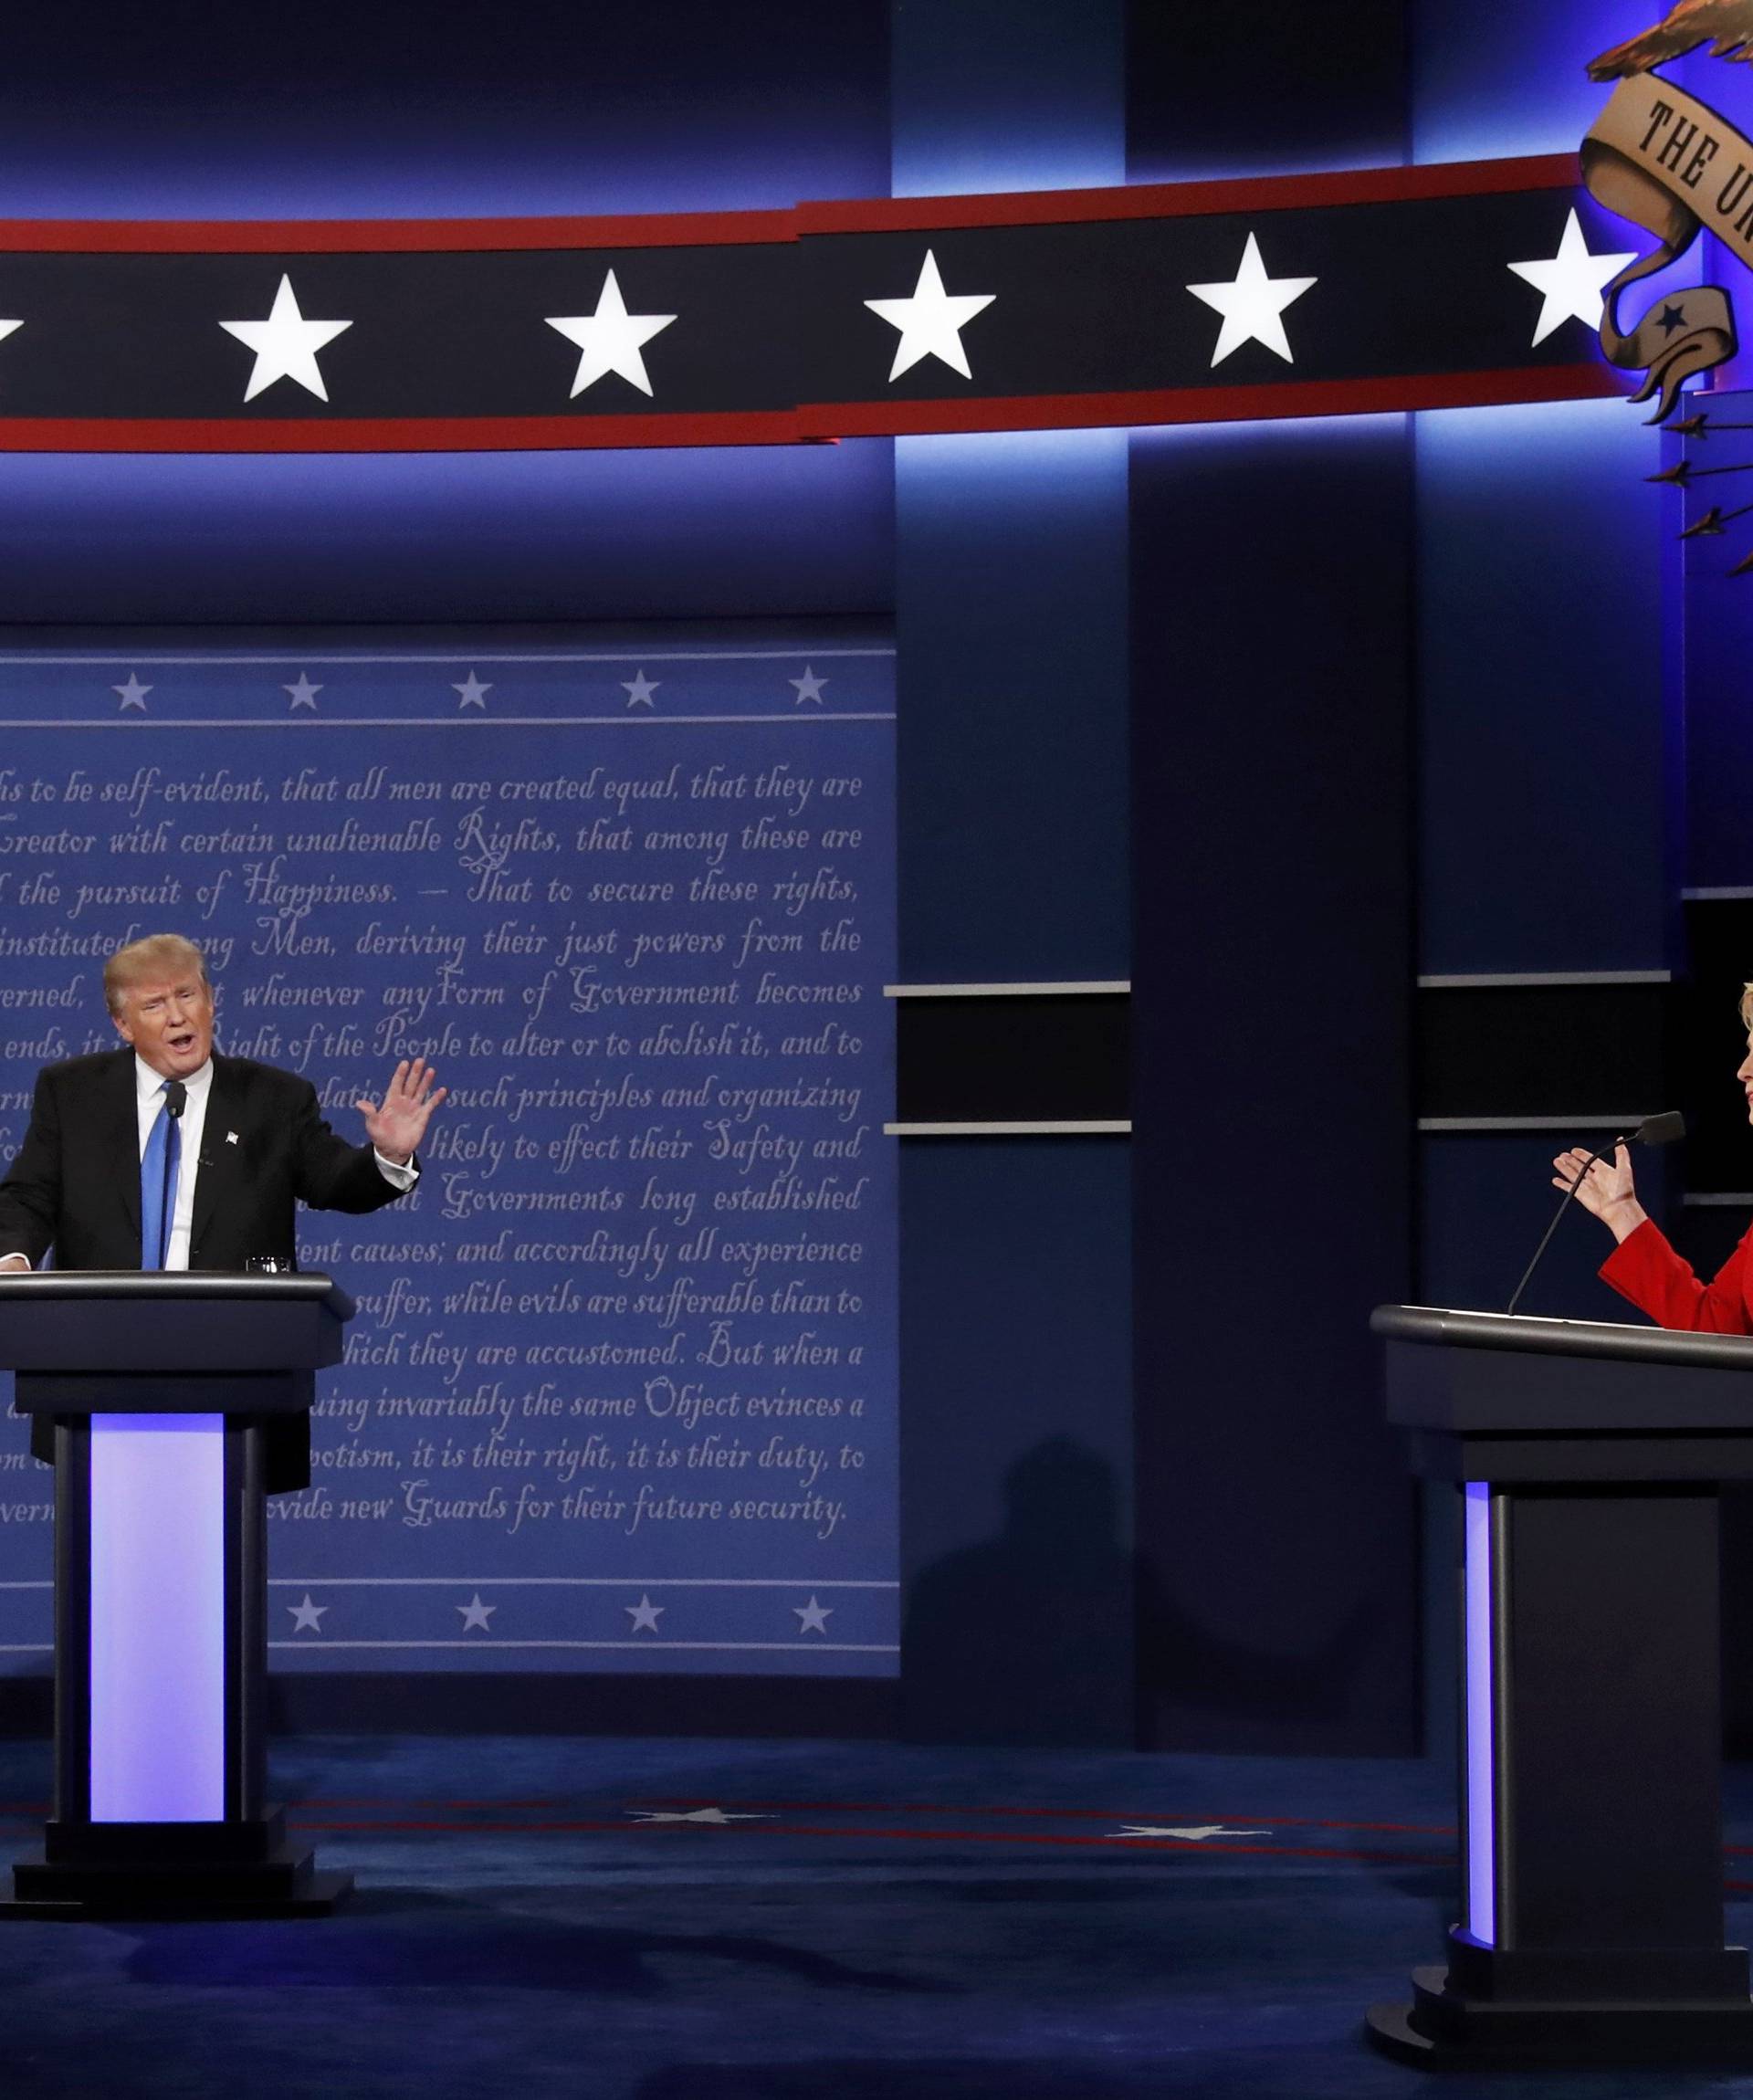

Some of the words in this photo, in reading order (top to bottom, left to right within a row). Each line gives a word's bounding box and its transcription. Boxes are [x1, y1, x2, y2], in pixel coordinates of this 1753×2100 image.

[1639, 100, 1720, 189] THE
[31, 779, 56, 803] to
[63, 771, 93, 802] be
[100, 767, 269, 818] self-evident,
[281, 768, 339, 802] that
[346, 766, 388, 801] all
[389, 782, 442, 800] men
[451, 782, 491, 800] are
[499, 767, 604, 800] created
[604, 763, 680, 815] equal,
[690, 764, 748, 799] that
[755, 763, 814, 816] they
[822, 778, 862, 796] are
[110, 819, 175, 854] with
[180, 824, 273, 853] certain
[287, 817, 441, 852] unalienable
[454, 805, 561, 868] Rights,
[577, 817, 633, 851] that
[645, 831, 729, 866] among
[741, 815, 809, 850] these
[822, 830, 862, 848] are
[19, 871, 60, 905] the
[67, 875, 182, 919] pursuit
[196, 869, 232, 919] of
[243, 855, 396, 917] Happiness.
[458, 853, 533, 902] That
[548, 877, 572, 902] to
[587, 883, 674, 902] secure
[689, 867, 758, 902] these
[772, 866, 857, 917] rights,
[251, 916, 336, 957] Men,
[356, 922, 466, 969] deriving
[484, 920, 548, 954] their
[555, 921, 617, 967] just
[625, 932, 726, 968] powers
[733, 917, 803, 969] from
[821, 918, 861, 951] the
[0, 974, 85, 1009] erned,
[242, 972, 365, 1007] whenever
[382, 987, 433, 1024] any
[436, 964, 505, 1005] Form
[522, 971, 558, 1021] of
[570, 965, 740, 1013] Government
[755, 971, 863, 1004] becomes
[5, 1026, 71, 1059] ends,
[289, 1023, 324, 1074] of
[323, 1024, 364, 1057] the
[373, 1007, 461, 1058] People
[469, 1032, 494, 1056] to
[502, 1022, 565, 1056] alter
[572, 1038, 599, 1055] or
[606, 1032, 631, 1057] to
[639, 1021, 740, 1055] abolish
[740, 1026, 769, 1057] it,
[781, 1023, 837, 1055] and
[838, 1031, 863, 1055] to
[446, 1076, 511, 1108] such
[508, 1073, 654, 1122] principles
[662, 1075, 719, 1108] and
[719, 1077, 861, 1123] organizing
[427, 1124, 505, 1179] likely
[515, 1135, 540, 1160] to
[549, 1123, 621, 1174] effect
[629, 1125, 693, 1160] their
[703, 1118, 803, 1176] Safety
[813, 1125, 870, 1158] and
[441, 1171, 625, 1219] Governments
[640, 1176, 697, 1226] long
[714, 1175, 870, 1211] established
[351, 1242, 446, 1265] causes;
[457, 1230, 513, 1262] and
[514, 1227, 669, 1282] accordingly
[678, 1227, 719, 1262] all
[721, 1233, 863, 1276] experience
[355, 1277, 432, 1328] suffer,
[443, 1278, 512, 1314] while
[519, 1278, 582, 1314] evils
[587, 1296, 627, 1314] are
[633, 1276, 764, 1328] sufferable
[771, 1279, 830, 1314] than
[838, 1288, 862, 1314] to
[342, 1330, 411, 1365] hich
[409, 1331, 467, 1384] they
[477, 1346, 517, 1365] are
[526, 1332, 686, 1365] accustomed.
[696, 1320, 764, 1368] But
[772, 1331, 838, 1365] when
[848, 1347, 864, 1365] a
[376, 1381, 515, 1436] invariably
[523, 1382, 562, 1416] the
[570, 1397, 636, 1416] same
[645, 1375, 740, 1430] Object
[746, 1387, 843, 1417] evinces
[849, 1399, 864, 1417] a
[412, 1438, 435, 1468] it
[442, 1438, 466, 1467] is
[473, 1432, 537, 1467] their
[544, 1433, 615, 1483] right,
[627, 1438, 649, 1468] it
[656, 1439, 681, 1467] is
[688, 1433, 751, 1468] their
[759, 1435, 828, 1487] duty,
[840, 1444, 865, 1469] to
[267, 1488, 333, 1520] ovide
[340, 1498, 394, 1519] new
[401, 1479, 508, 1528] Guards
[507, 1484, 555, 1535] for
[562, 1486, 626, 1519] their
[625, 1485, 722, 1536] future
[729, 1491, 846, 1539] security.
